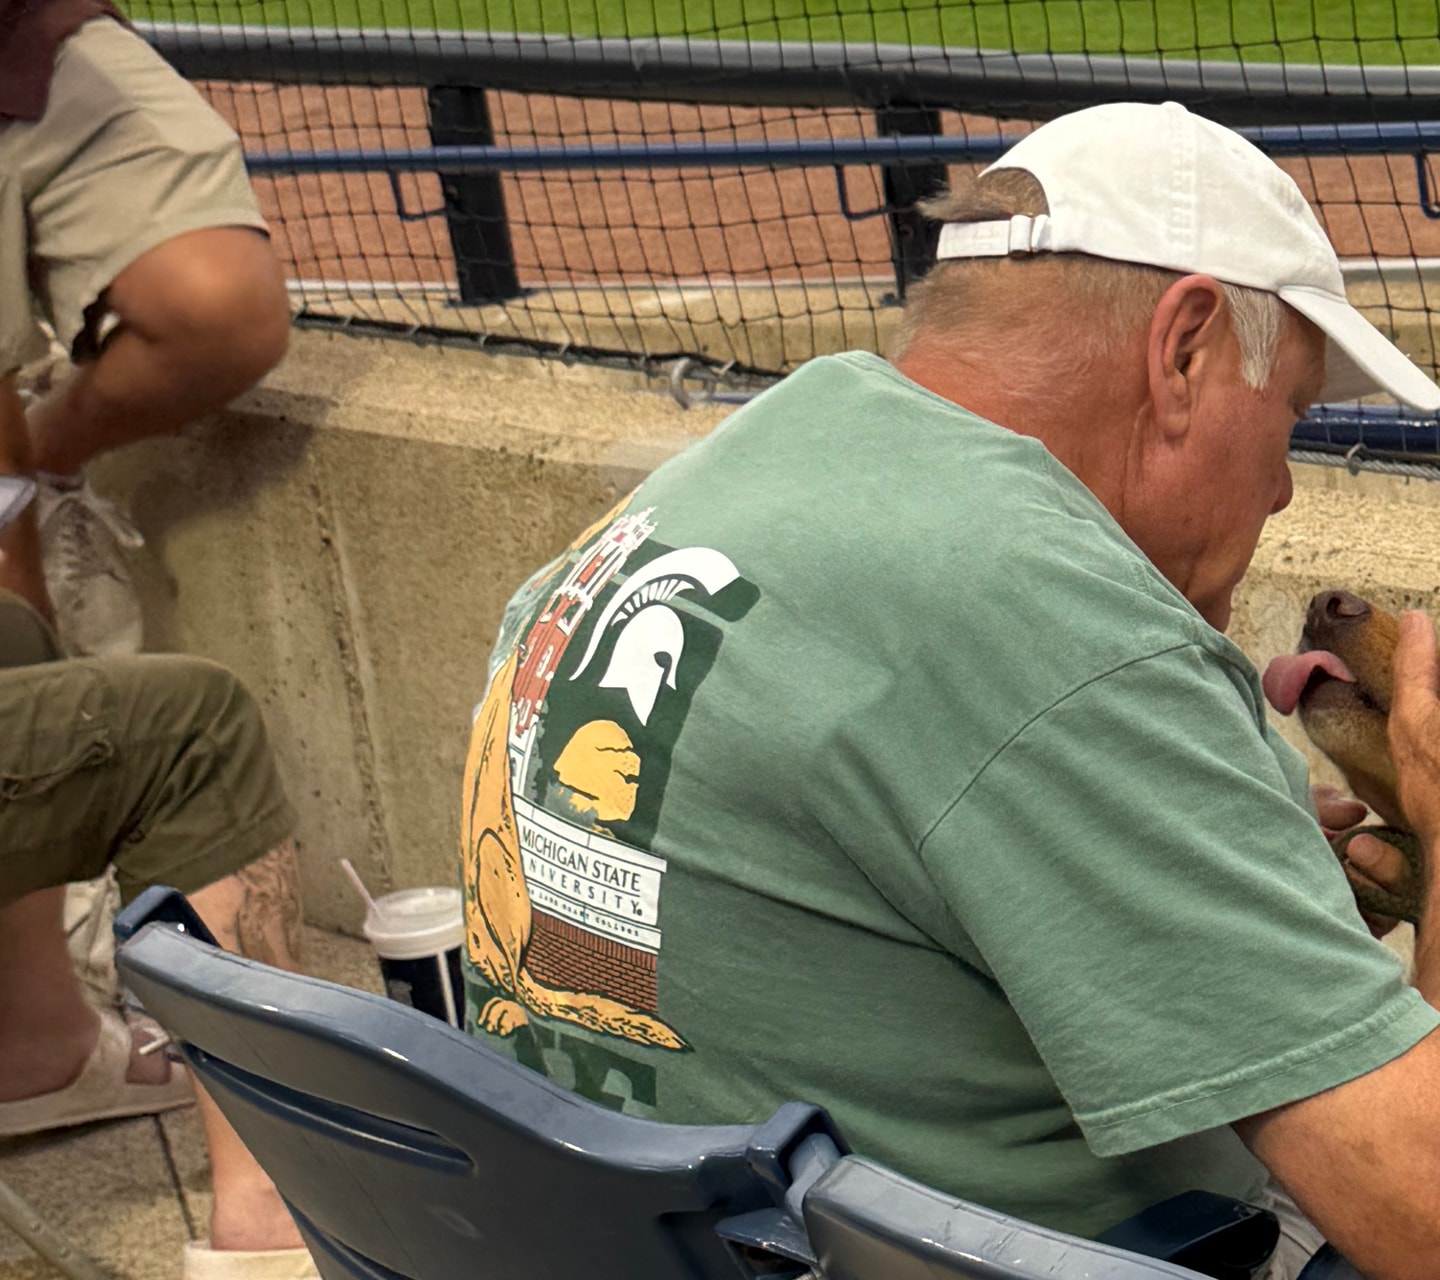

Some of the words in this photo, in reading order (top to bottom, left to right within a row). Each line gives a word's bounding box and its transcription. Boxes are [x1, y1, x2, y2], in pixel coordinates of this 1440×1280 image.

[522, 825, 589, 875] MICHIGAN
[592, 860, 641, 893] STATE
[529, 858, 639, 915] NIVERSITY
